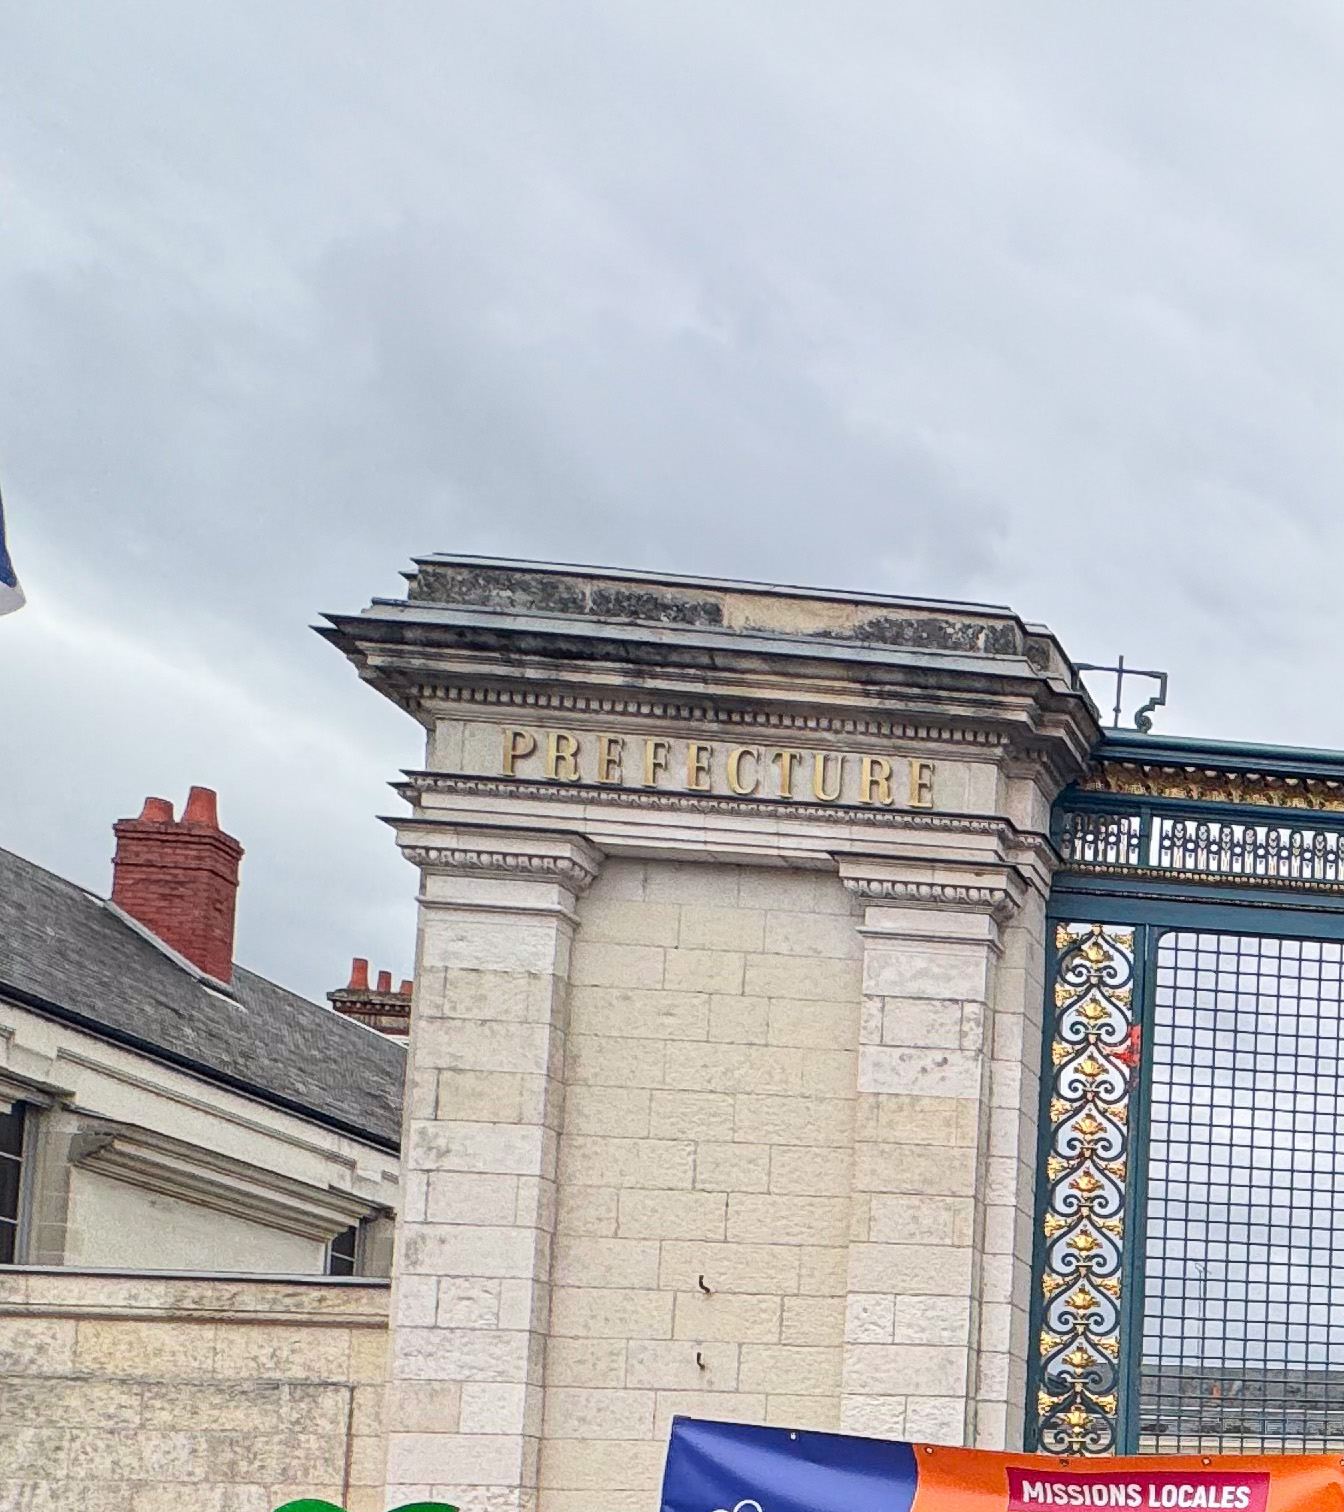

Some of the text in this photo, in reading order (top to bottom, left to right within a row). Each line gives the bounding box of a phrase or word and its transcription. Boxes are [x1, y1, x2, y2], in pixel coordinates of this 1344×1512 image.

[502, 729, 937, 809] PREFECTURE
[1022, 1480, 1251, 1508] MISSIONS LOCALES
